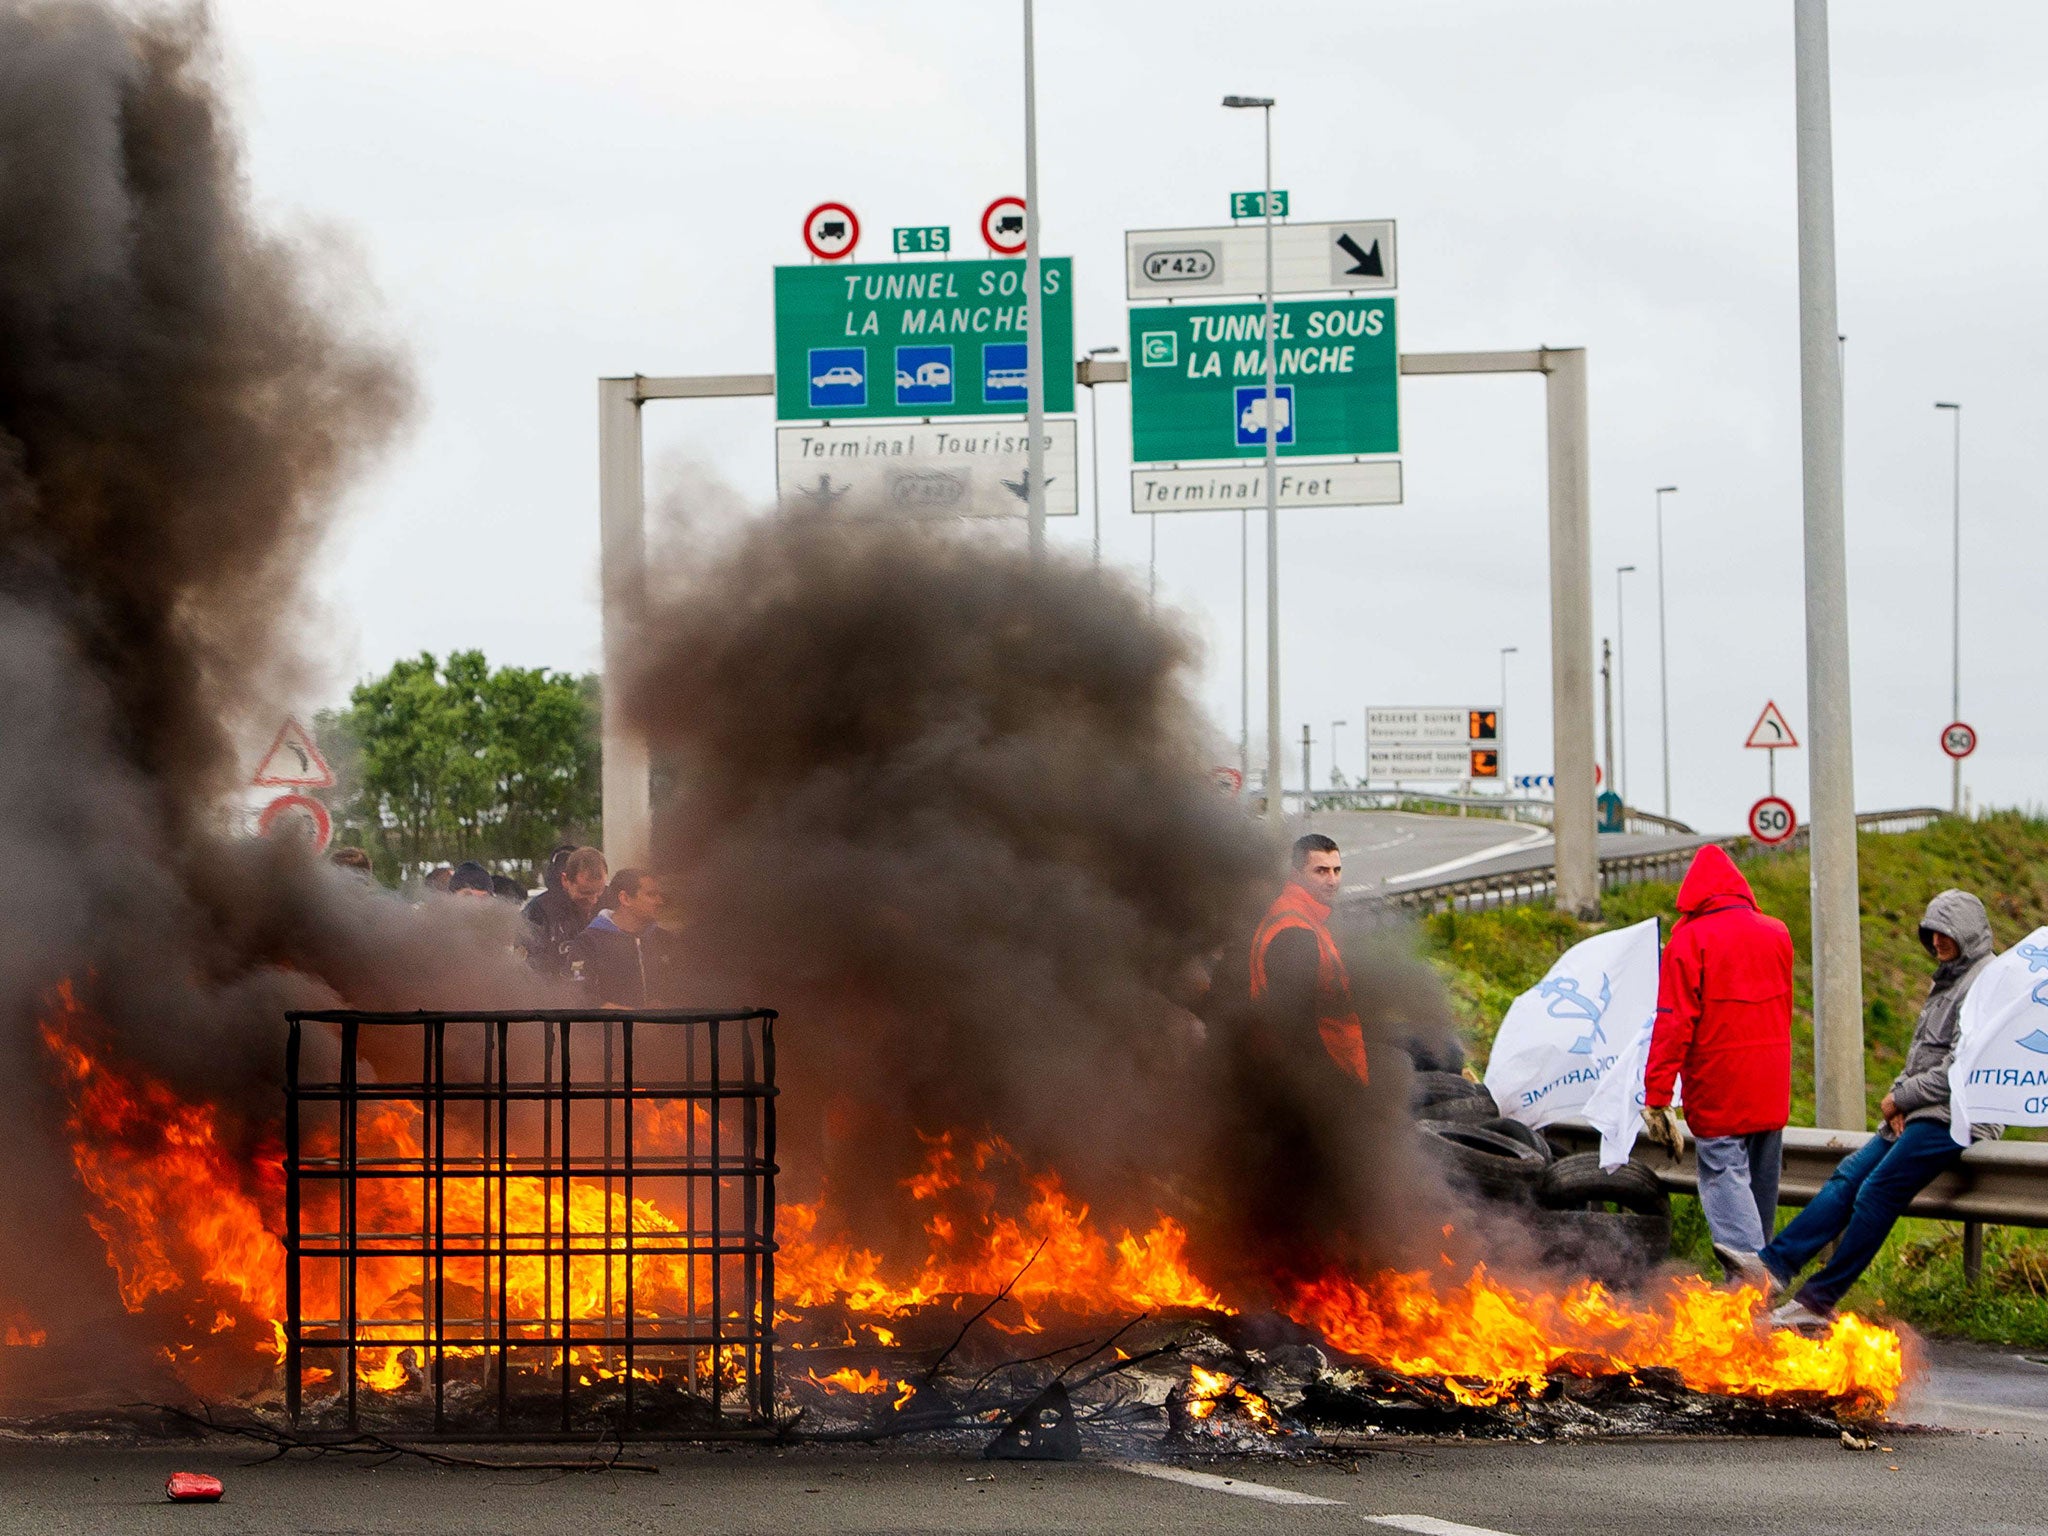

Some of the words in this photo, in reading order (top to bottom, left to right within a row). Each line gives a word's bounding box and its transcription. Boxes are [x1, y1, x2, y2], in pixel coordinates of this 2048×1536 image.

[1235, 195, 1247, 216] E
[1255, 193, 1283, 215] 15
[898, 230, 910, 251] E
[917, 229, 945, 251] 15
[844, 272, 959, 300] TUNNEL
[844, 311, 879, 336] LA
[902, 306, 1029, 334] MANCHE
[1189, 313, 1295, 343] TUNNEL
[1307, 309, 1384, 338] SOUS
[1187, 351, 1222, 378] LA
[1233, 346, 1355, 377] MANCHE
[801, 436, 915, 457] Terminal
[1145, 479, 1259, 501] Terminal
[1280, 476, 1332, 496] Fret
[1949, 732, 1970, 748] 50
[1759, 811, 1787, 830] 50
